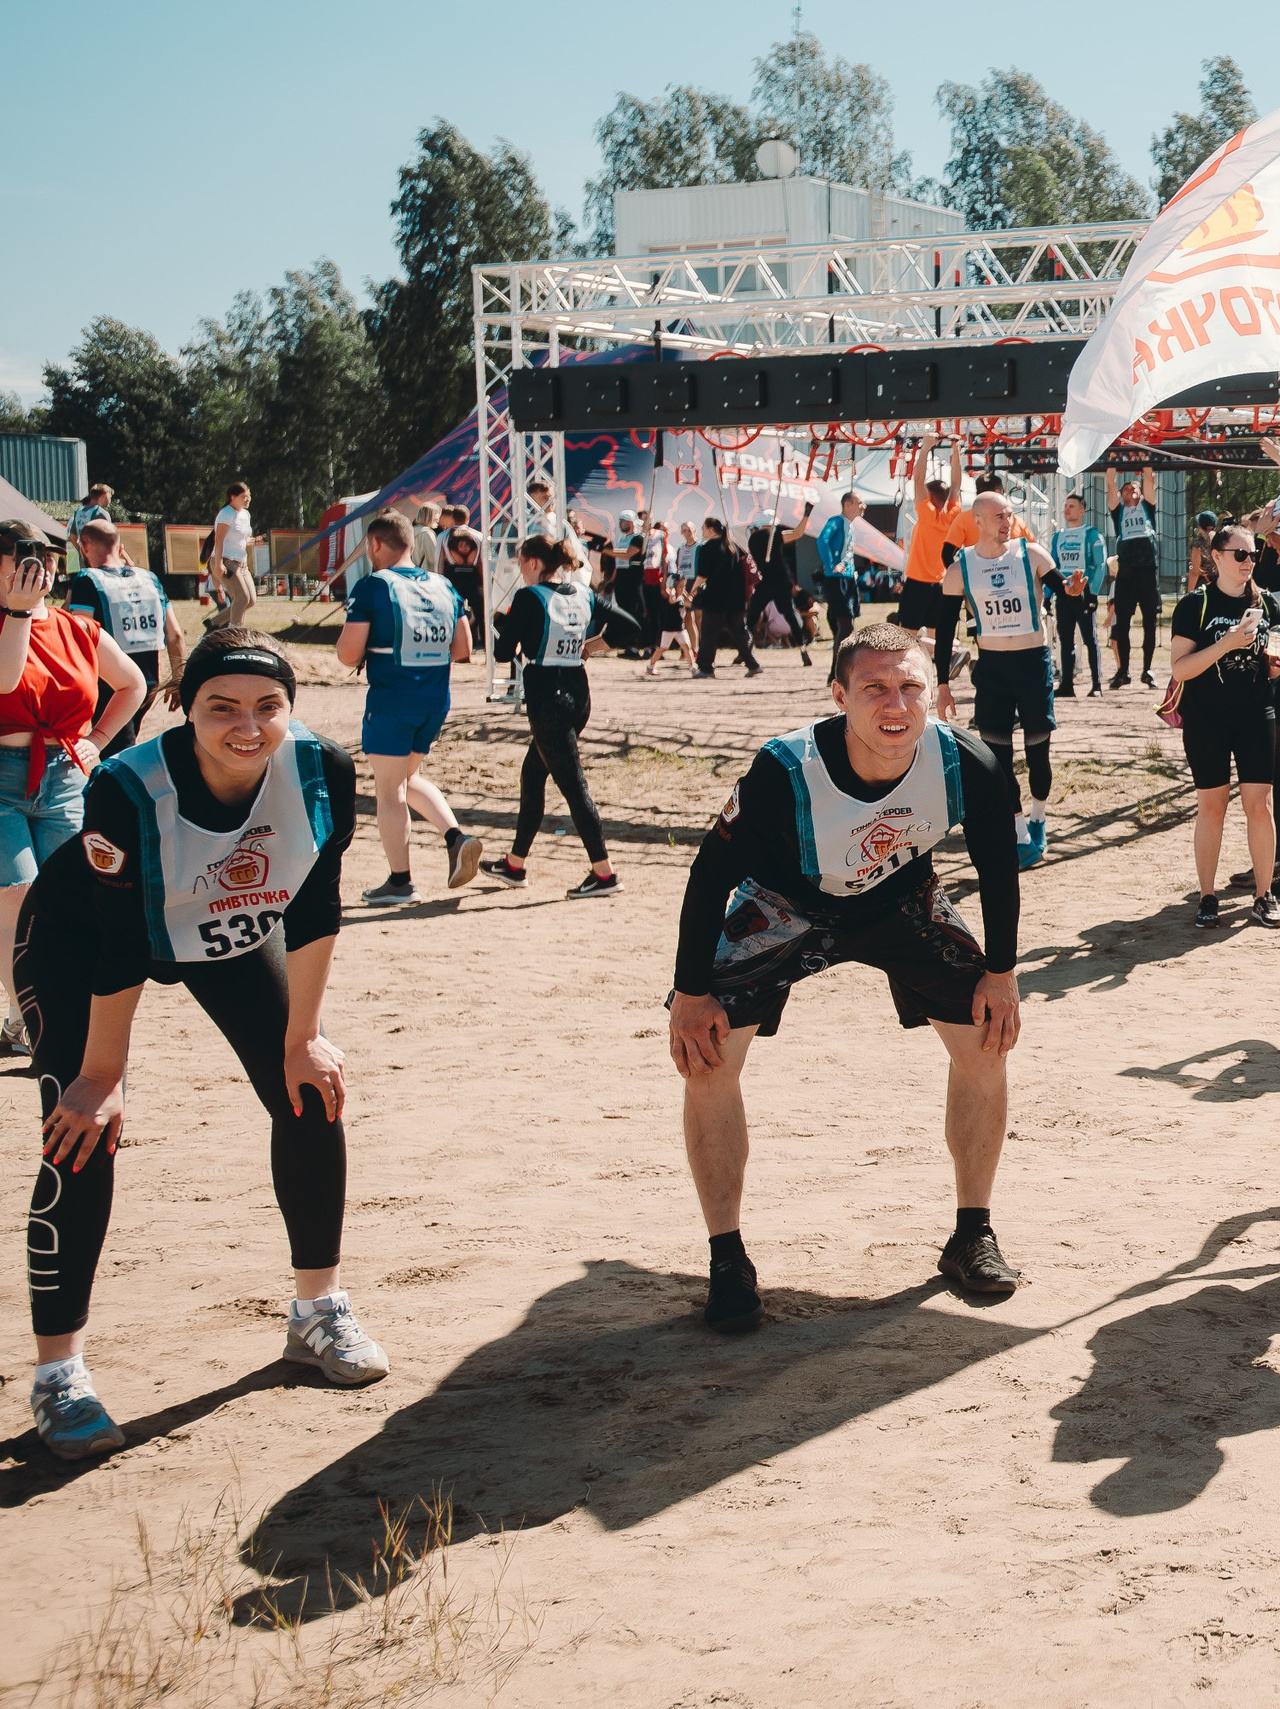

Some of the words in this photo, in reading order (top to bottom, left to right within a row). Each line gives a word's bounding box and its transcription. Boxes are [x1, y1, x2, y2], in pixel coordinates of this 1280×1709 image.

[722, 470, 821, 504] ГЕРОЕВ
[985, 597, 1022, 615] 5190
[122, 614, 157, 632] 5185
[209, 889, 290, 914] ПИВТОЧКА
[198, 910, 283, 958] 530
